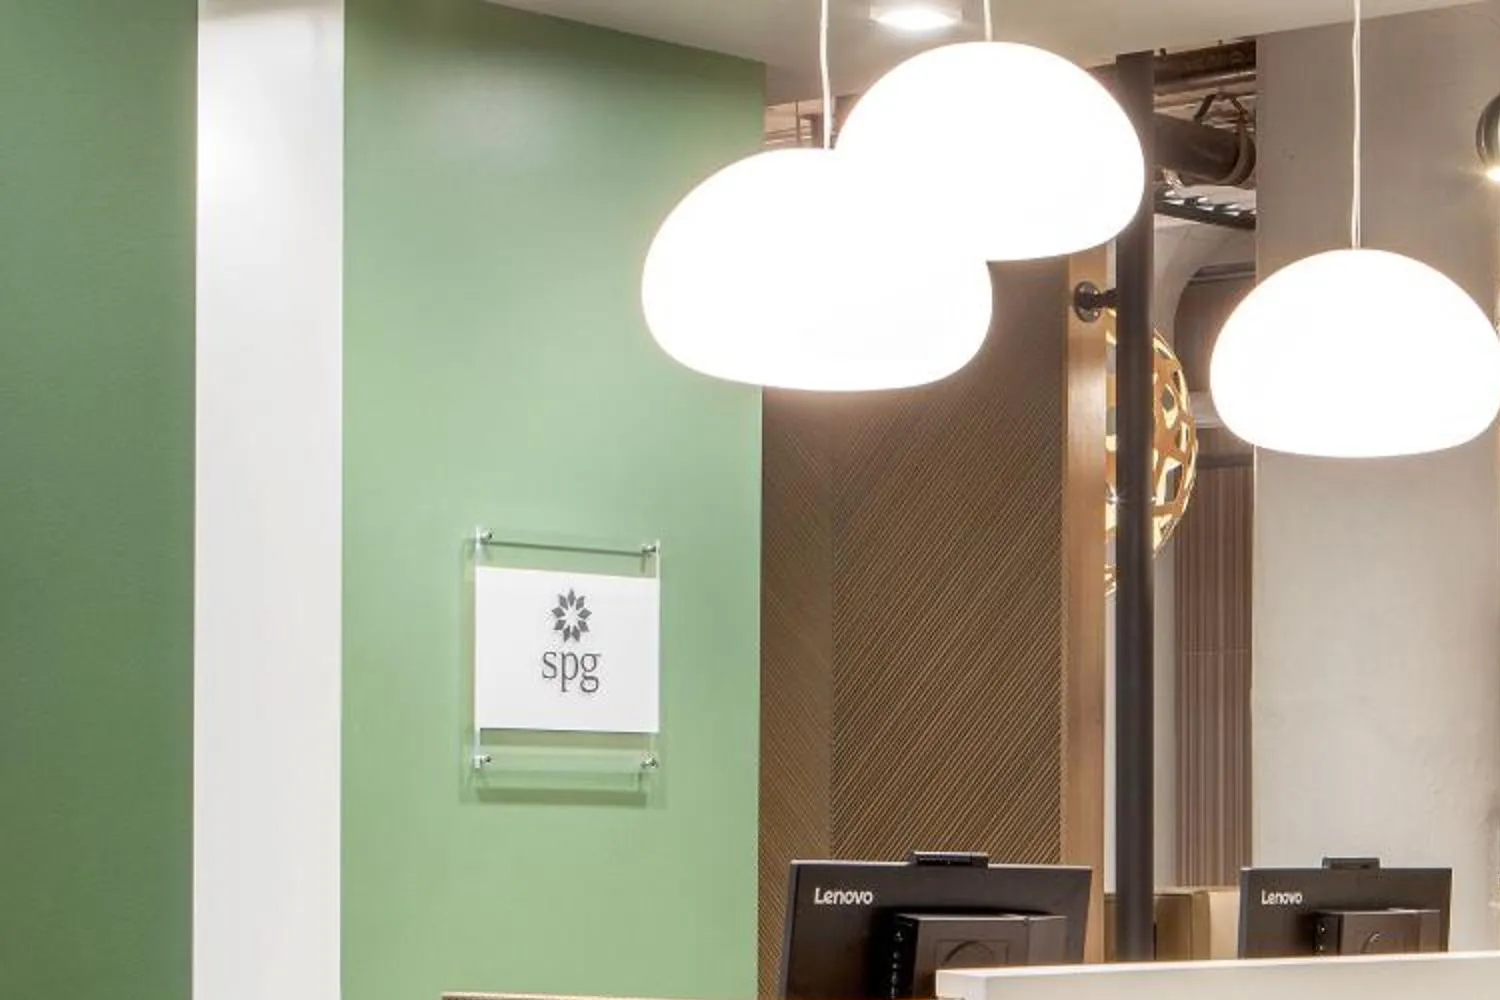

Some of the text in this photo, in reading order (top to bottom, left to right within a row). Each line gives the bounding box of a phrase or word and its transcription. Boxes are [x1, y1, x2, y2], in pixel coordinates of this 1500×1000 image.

[541, 651, 602, 693] spg
[814, 887, 873, 905] Lenovo
[1261, 889, 1303, 905] Lenovo
